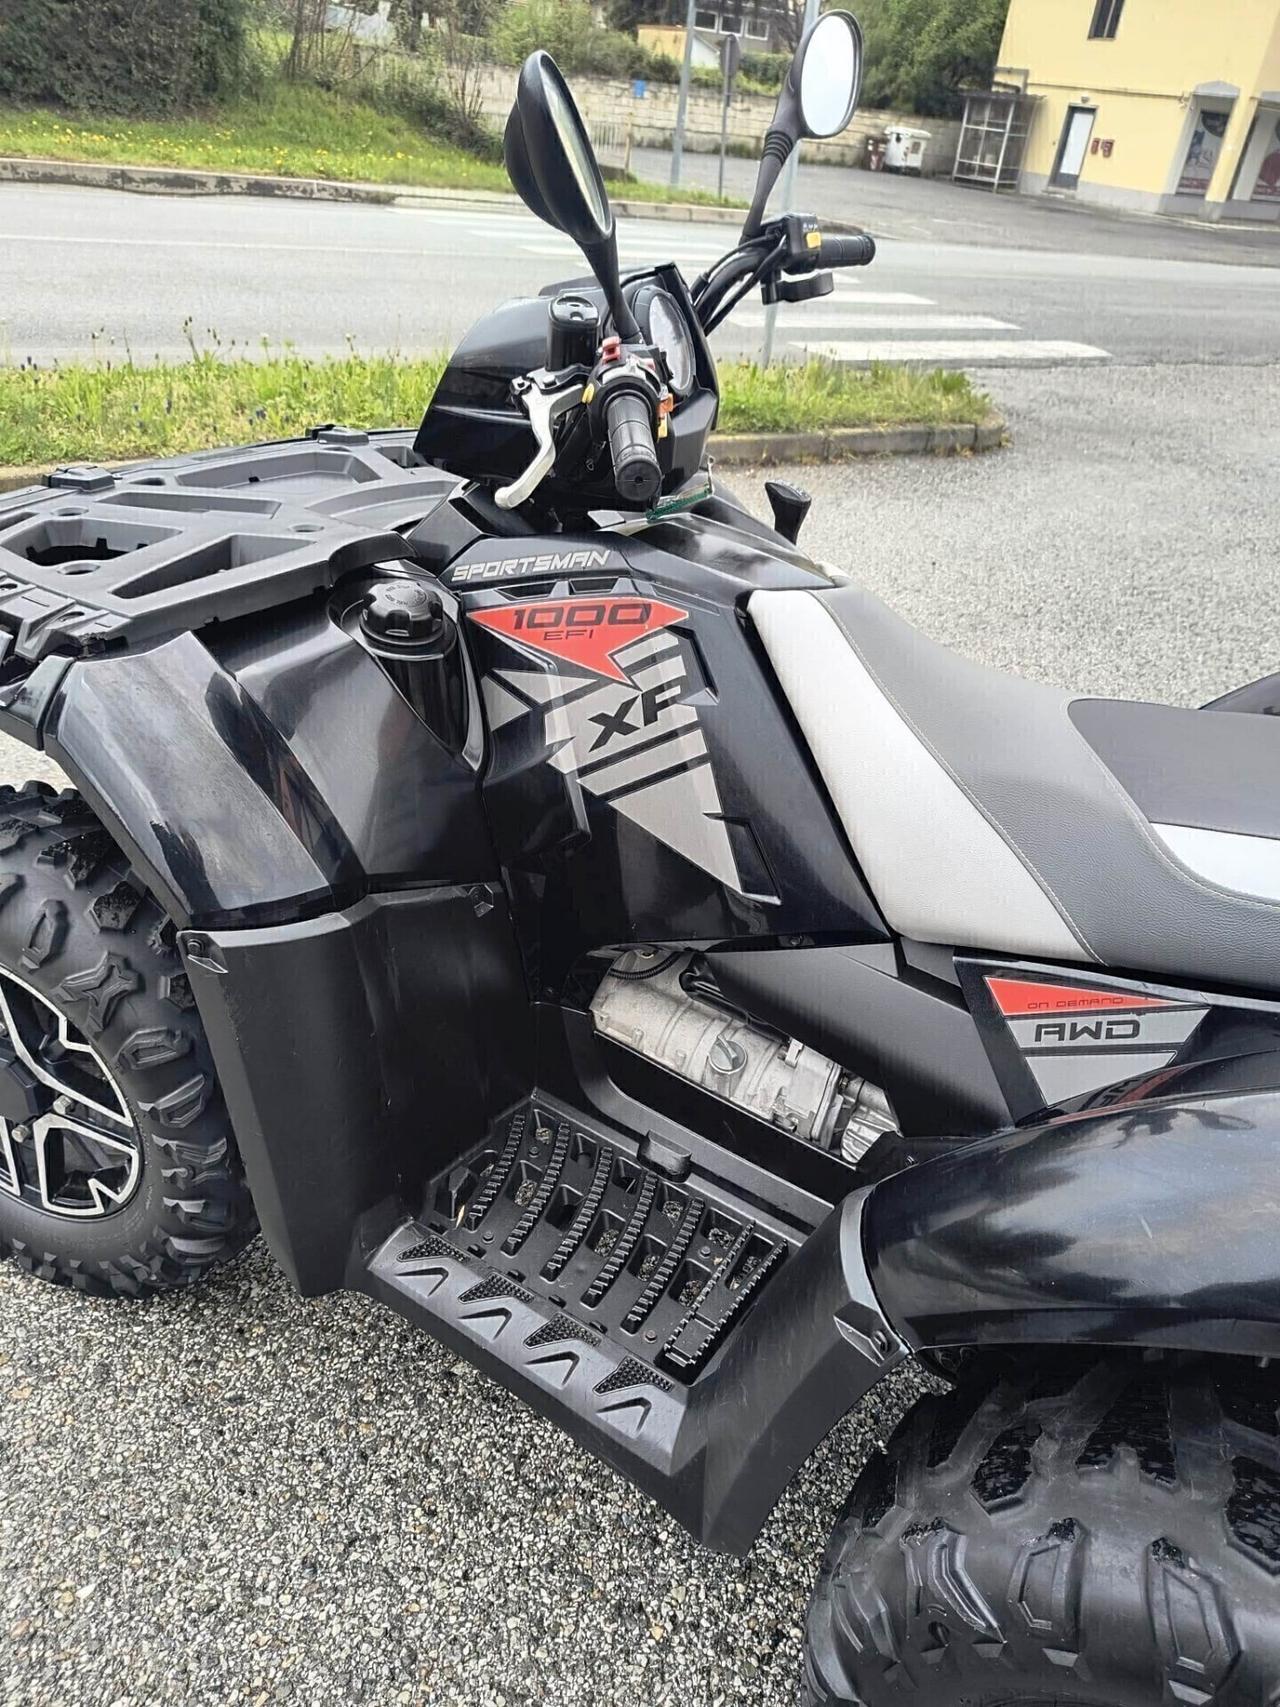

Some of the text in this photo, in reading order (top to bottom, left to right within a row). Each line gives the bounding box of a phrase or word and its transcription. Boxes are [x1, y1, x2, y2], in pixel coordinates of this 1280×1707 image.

[451, 549, 611, 582] SPORTSMAN
[513, 603, 652, 630] 1000
[543, 628, 593, 641] EFI
[1034, 1019, 1141, 1043] AWD
